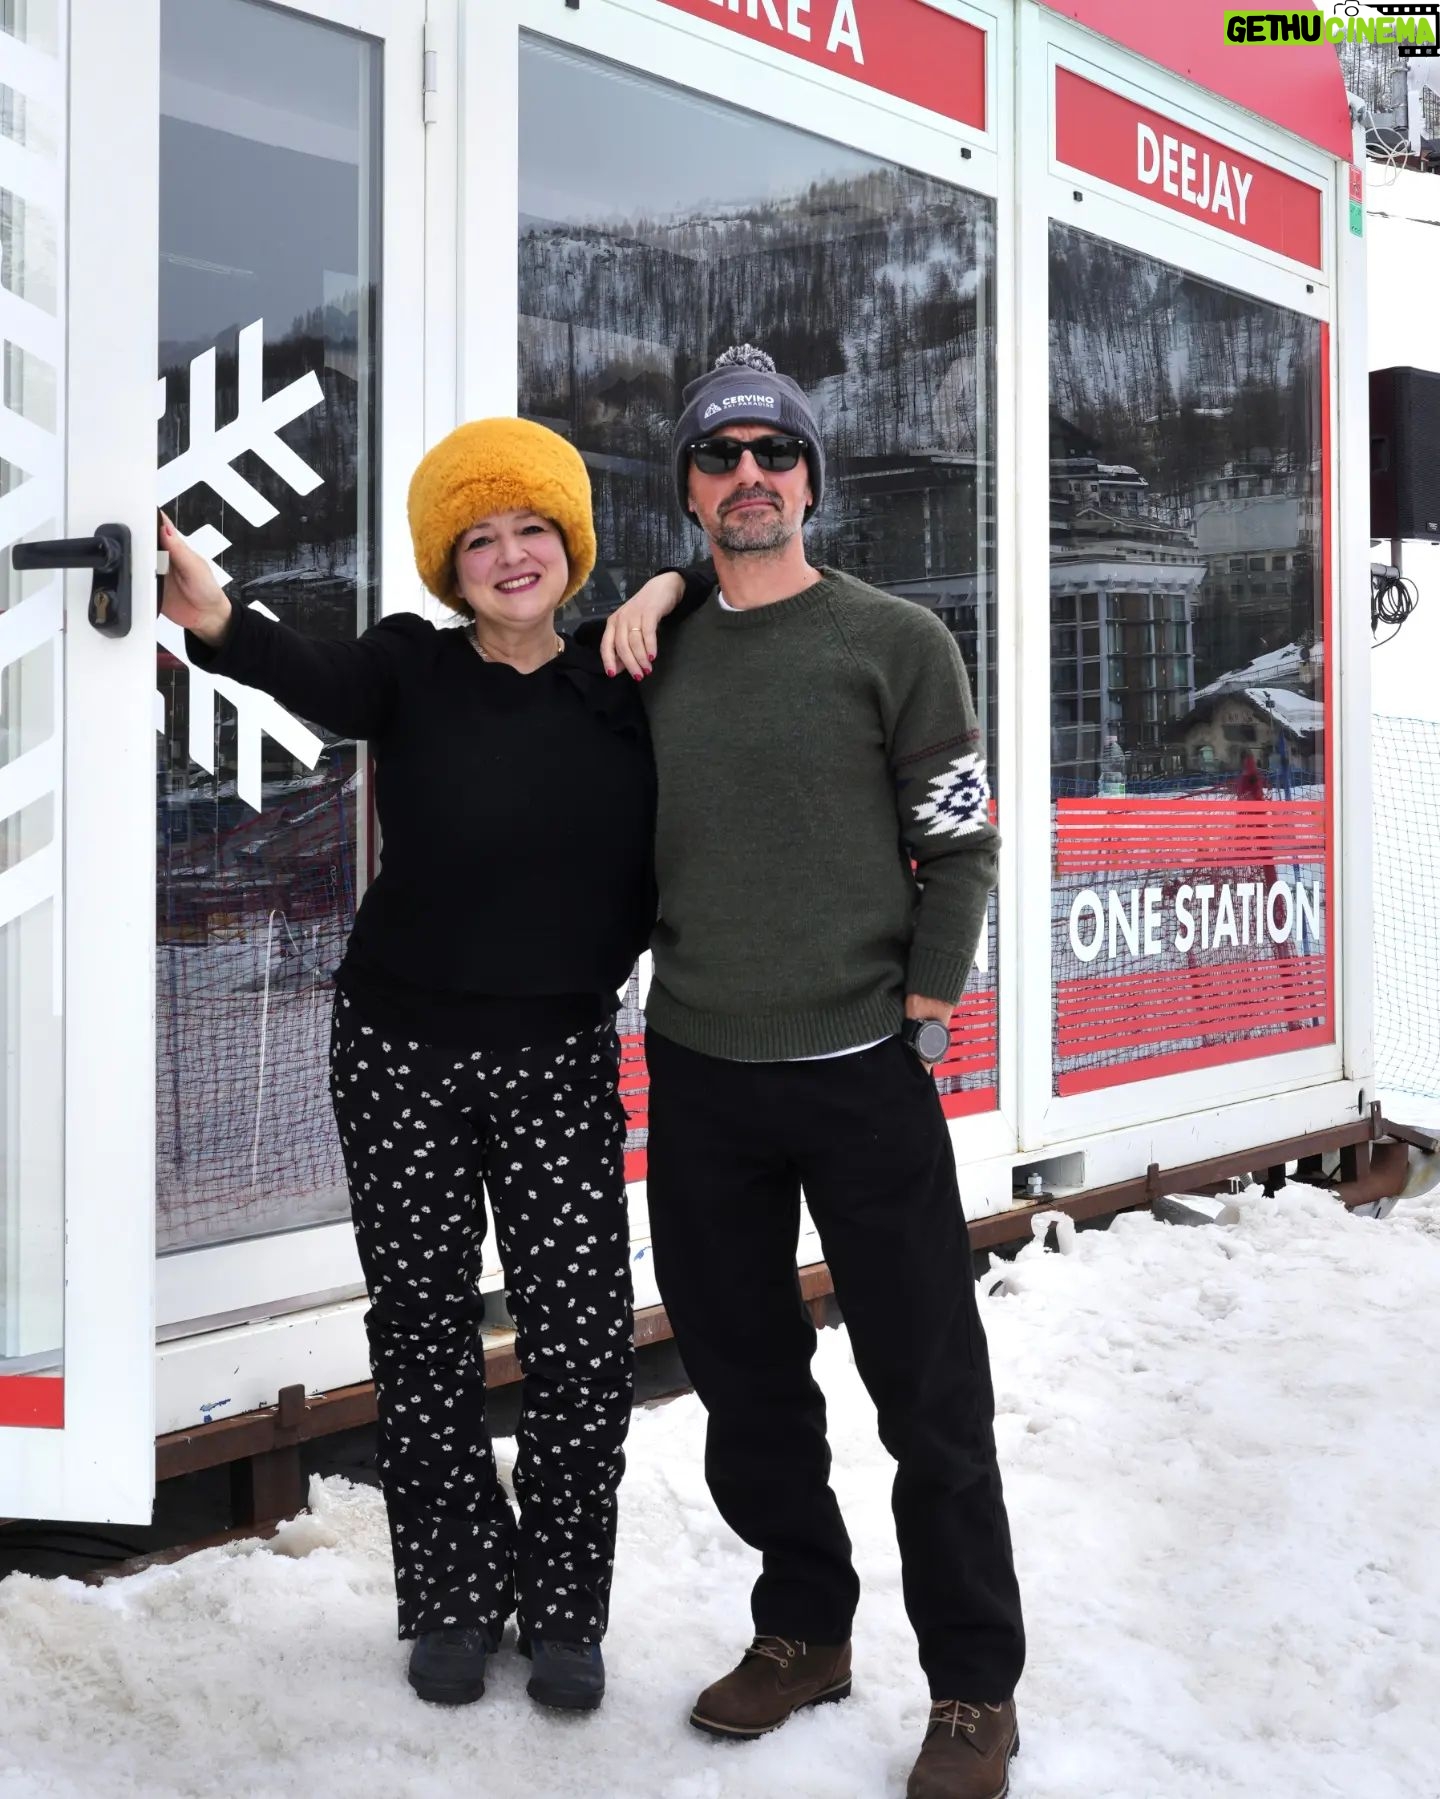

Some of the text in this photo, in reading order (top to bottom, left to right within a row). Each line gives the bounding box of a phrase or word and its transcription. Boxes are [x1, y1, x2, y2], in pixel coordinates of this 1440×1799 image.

[826, 0, 864, 65] A
[1137, 121, 1254, 225] DEEJAY
[722, 394, 775, 404] CERVINO
[1069, 888, 1163, 962] ONE
[1174, 880, 1321, 953] STATION
